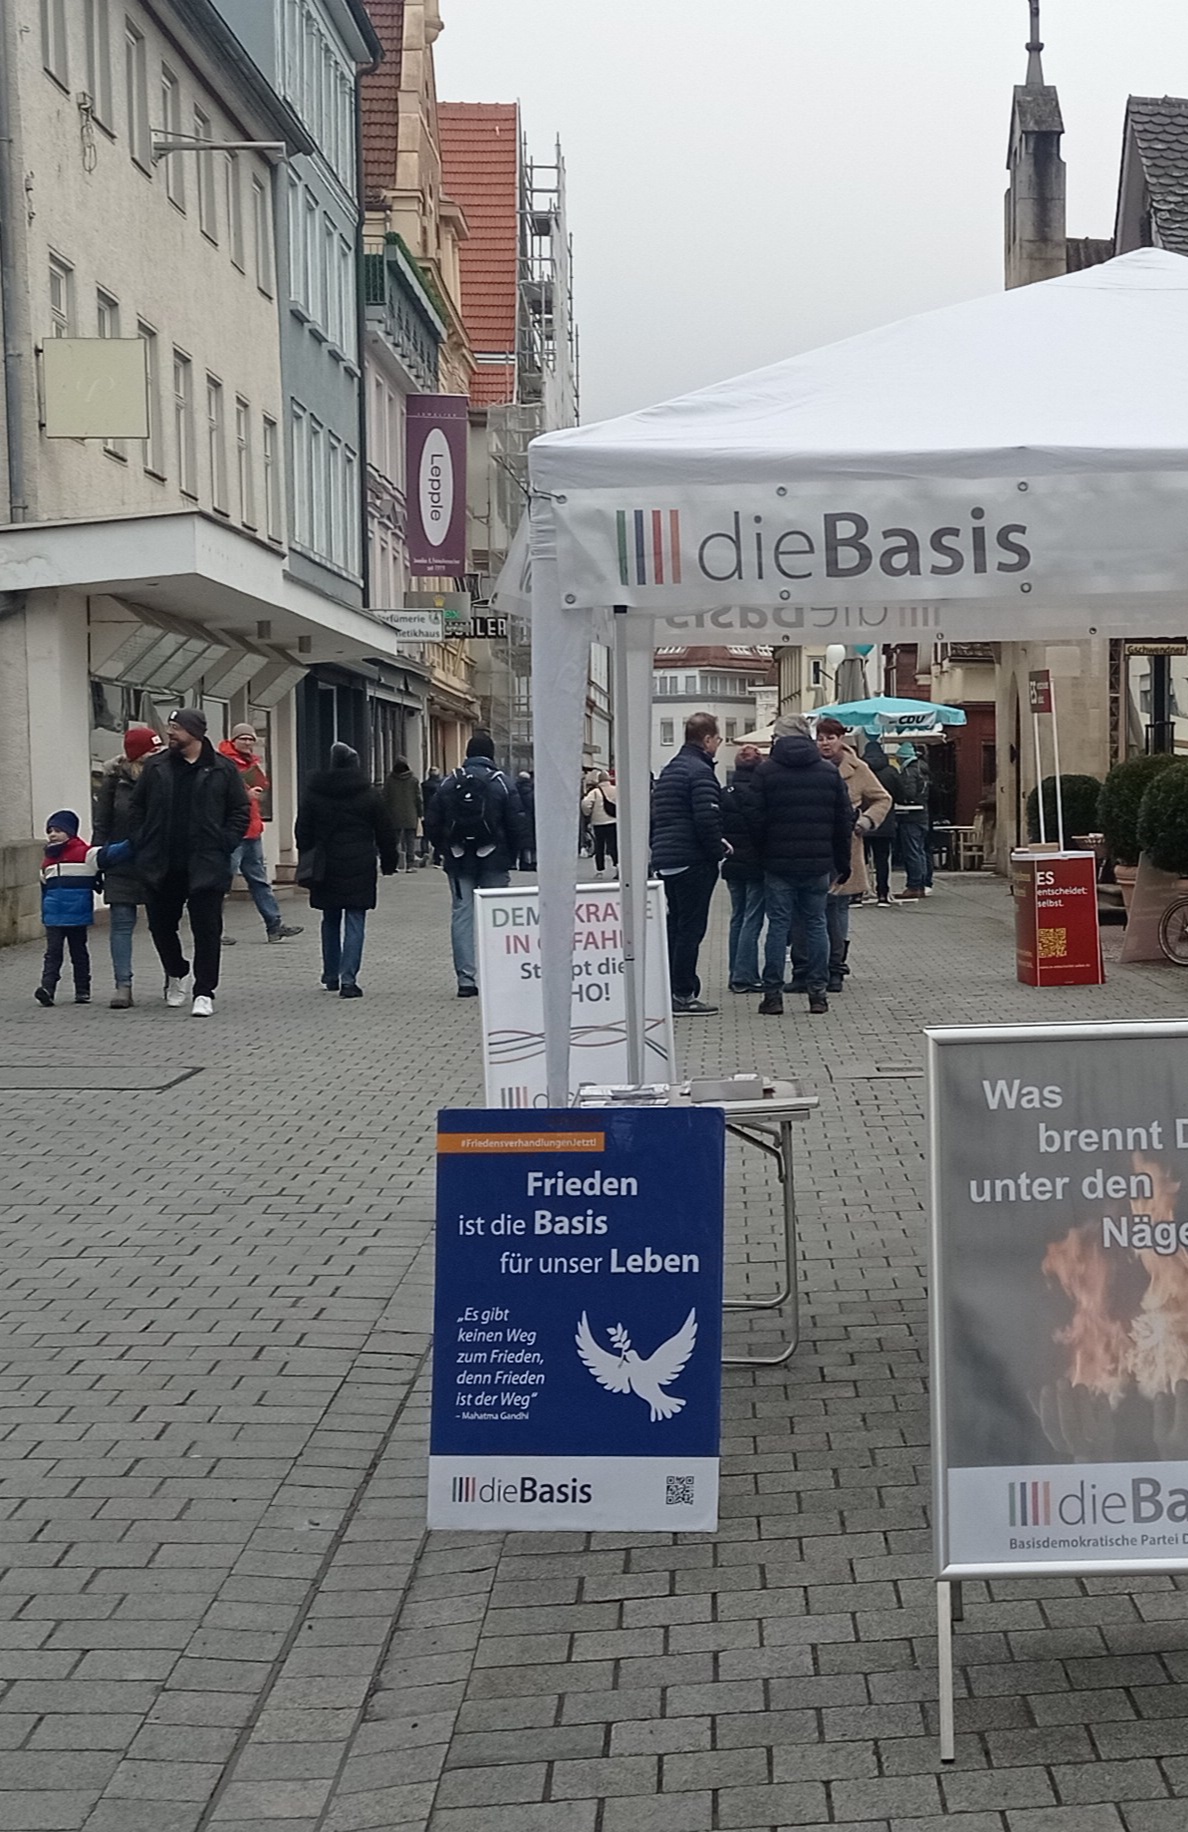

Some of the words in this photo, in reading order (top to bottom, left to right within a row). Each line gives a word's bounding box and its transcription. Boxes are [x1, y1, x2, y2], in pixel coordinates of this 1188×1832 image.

[427, 453, 444, 521] Lepple
[698, 506, 1031, 581] dieBasis
[898, 715, 926, 725] CDU
[1036, 871, 1055, 885] ES
[505, 933, 531, 954] IN
[983, 1079, 1063, 1109] Was
[1039, 1120, 1163, 1152] brennt
[527, 1170, 638, 1196] Frieden
[969, 1172, 1069, 1203] unter
[1081, 1168, 1152, 1200] den
[458, 1215, 485, 1236] ist
[491, 1214, 526, 1235] die
[534, 1209, 608, 1235] Basis
[500, 1251, 532, 1274] für
[538, 1255, 603, 1274] unser
[609, 1247, 699, 1273] Leben
[480, 1307, 510, 1326] gibt
[457, 1328, 503, 1343] keinen
[506, 1329, 537, 1346] Weg
[456, 1353, 486, 1364] zum
[489, 1350, 545, 1366] Frieden,
[456, 1370, 492, 1385] denn
[494, 1370, 545, 1385] Frieden
[456, 1392, 471, 1406] ist
[474, 1391, 498, 1406] der
[461, 1411, 499, 1421] Mahatma
[500, 1410, 529, 1421] Gandhi
[478, 1476, 593, 1504] dieBasis
[1009, 1534, 1138, 1550] Basisdemokratische
[1140, 1533, 1179, 1546] Partei
